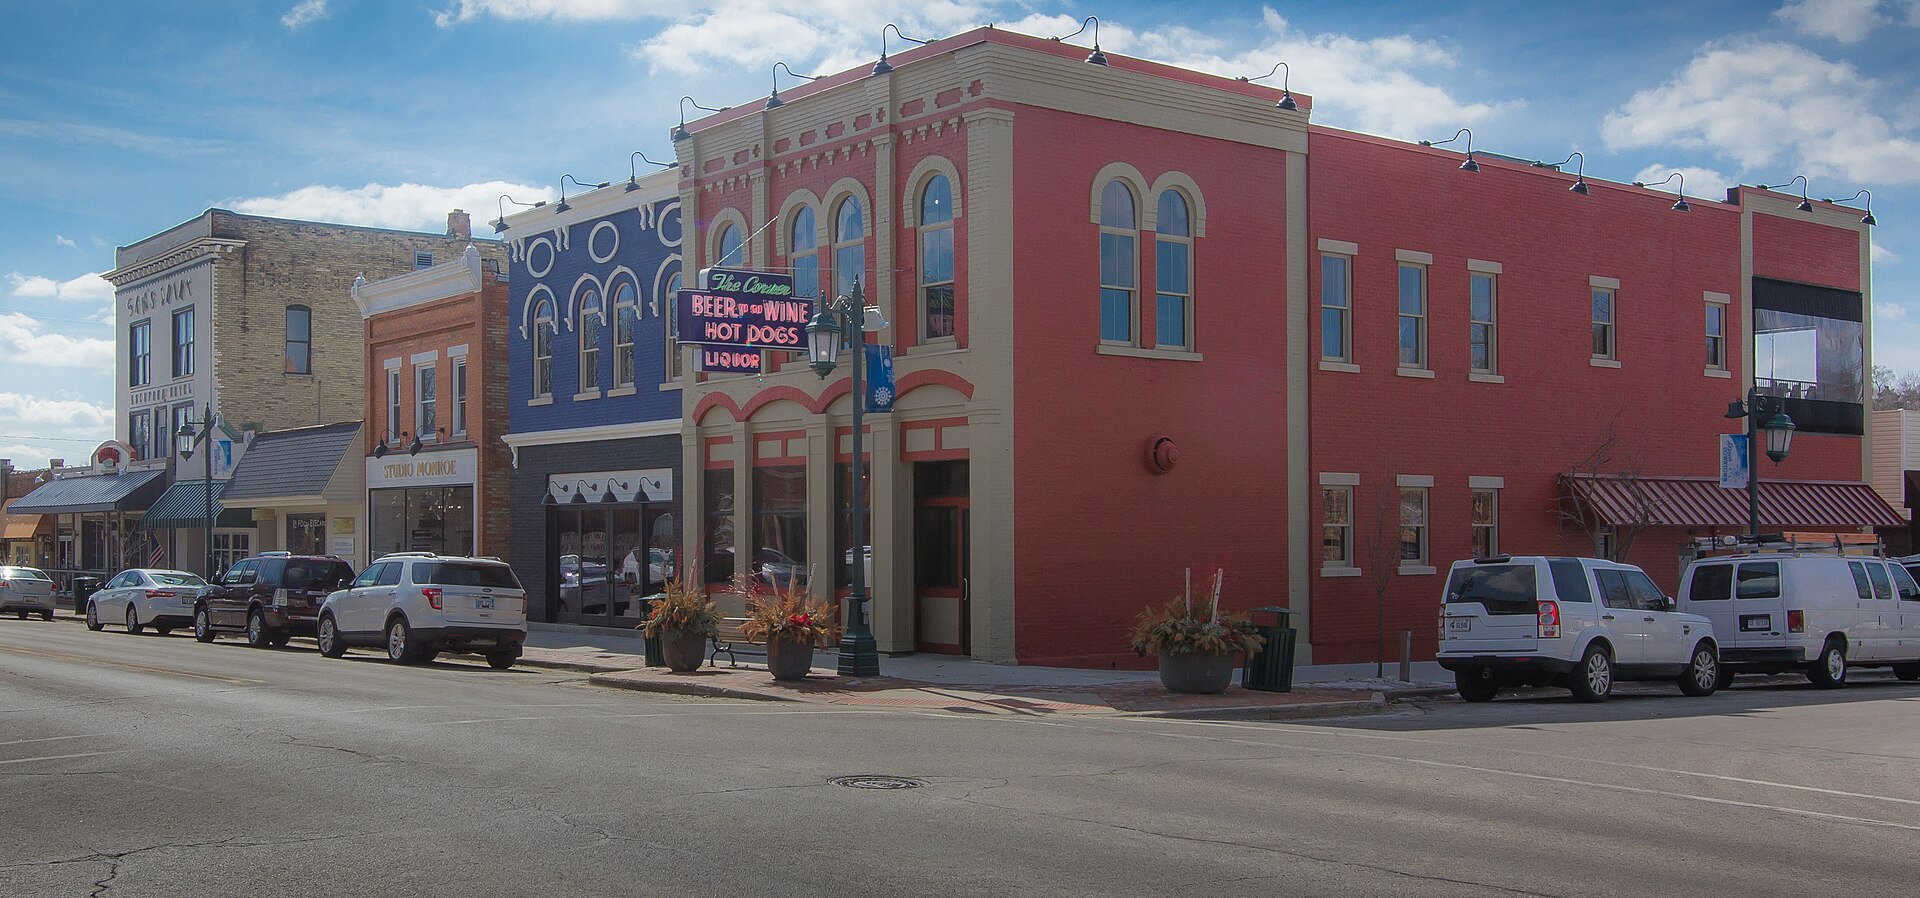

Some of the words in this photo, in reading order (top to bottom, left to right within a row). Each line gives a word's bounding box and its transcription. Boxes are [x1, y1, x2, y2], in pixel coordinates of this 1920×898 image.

[711, 273, 741, 292] The
[743, 276, 791, 295] Corner
[692, 294, 739, 318] BEER
[764, 300, 808, 323] WINE
[705, 321, 742, 341] HOT
[747, 324, 799, 345] DOGS
[705, 351, 760, 369] LIQUOR
[383, 462, 414, 479] STUDIO
[416, 460, 457, 477] MONROE
